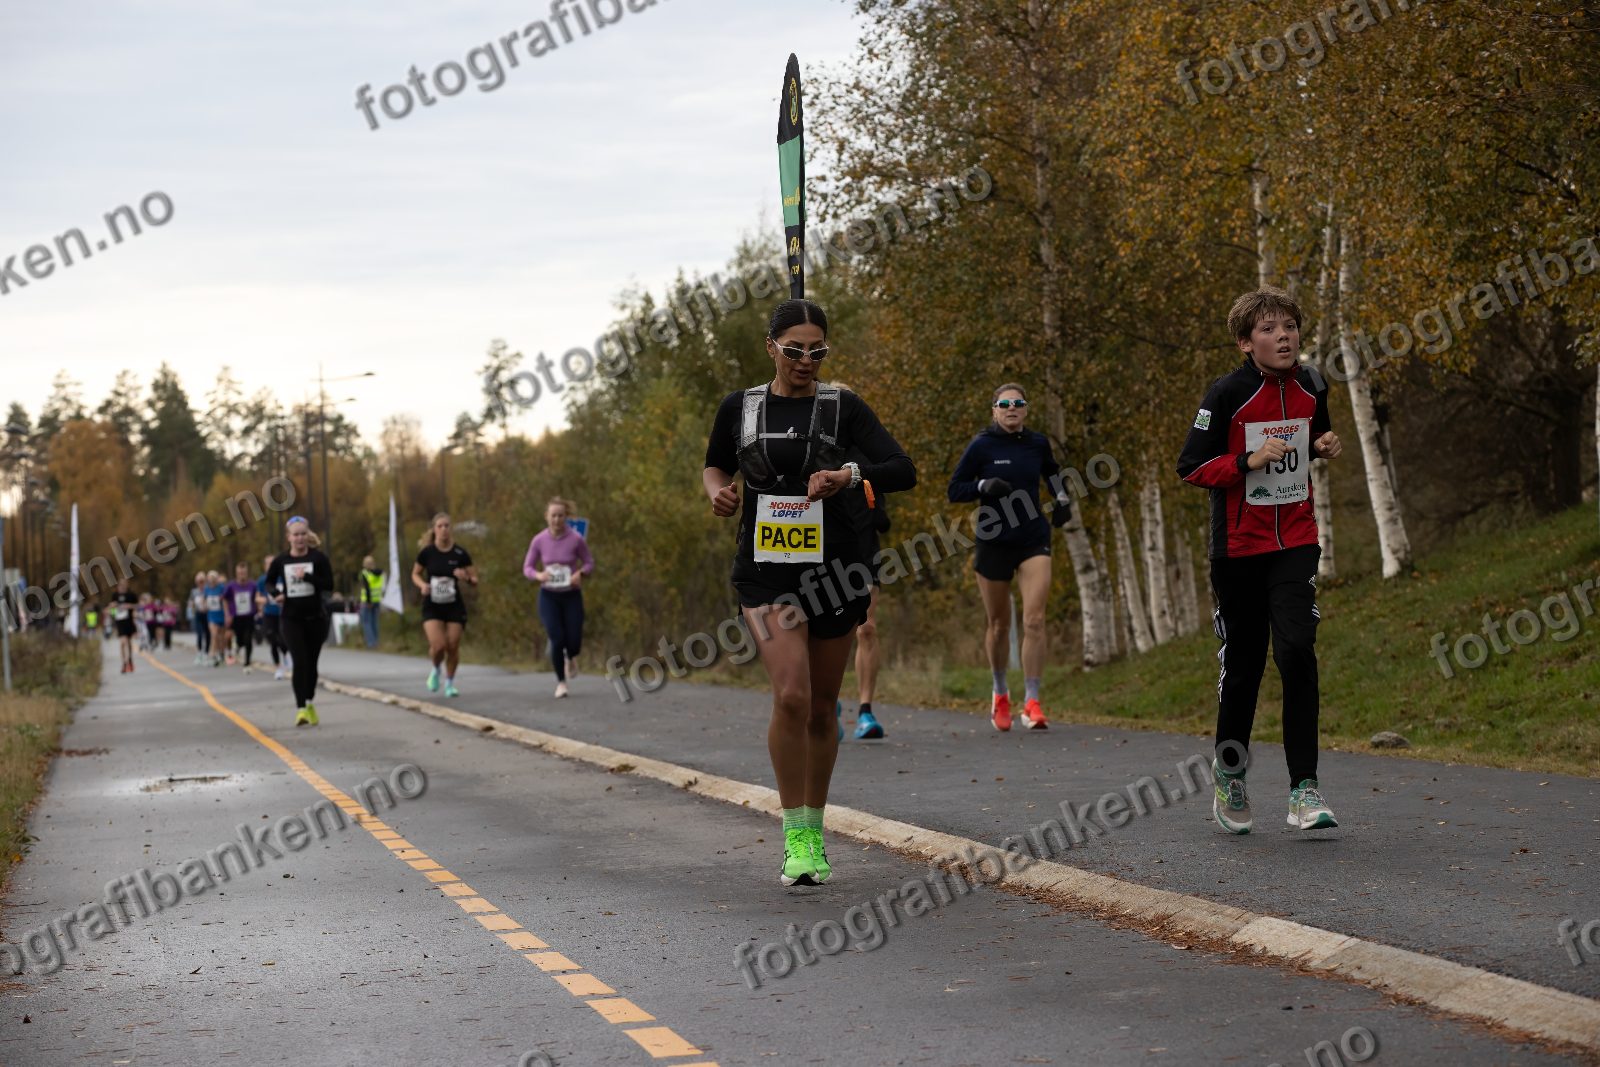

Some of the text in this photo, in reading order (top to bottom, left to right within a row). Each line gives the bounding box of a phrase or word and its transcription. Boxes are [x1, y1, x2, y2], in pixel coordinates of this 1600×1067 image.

[1262, 425, 1299, 435] NORGES
[769, 502, 811, 510] NORGES
[761, 526, 816, 548] PACE
